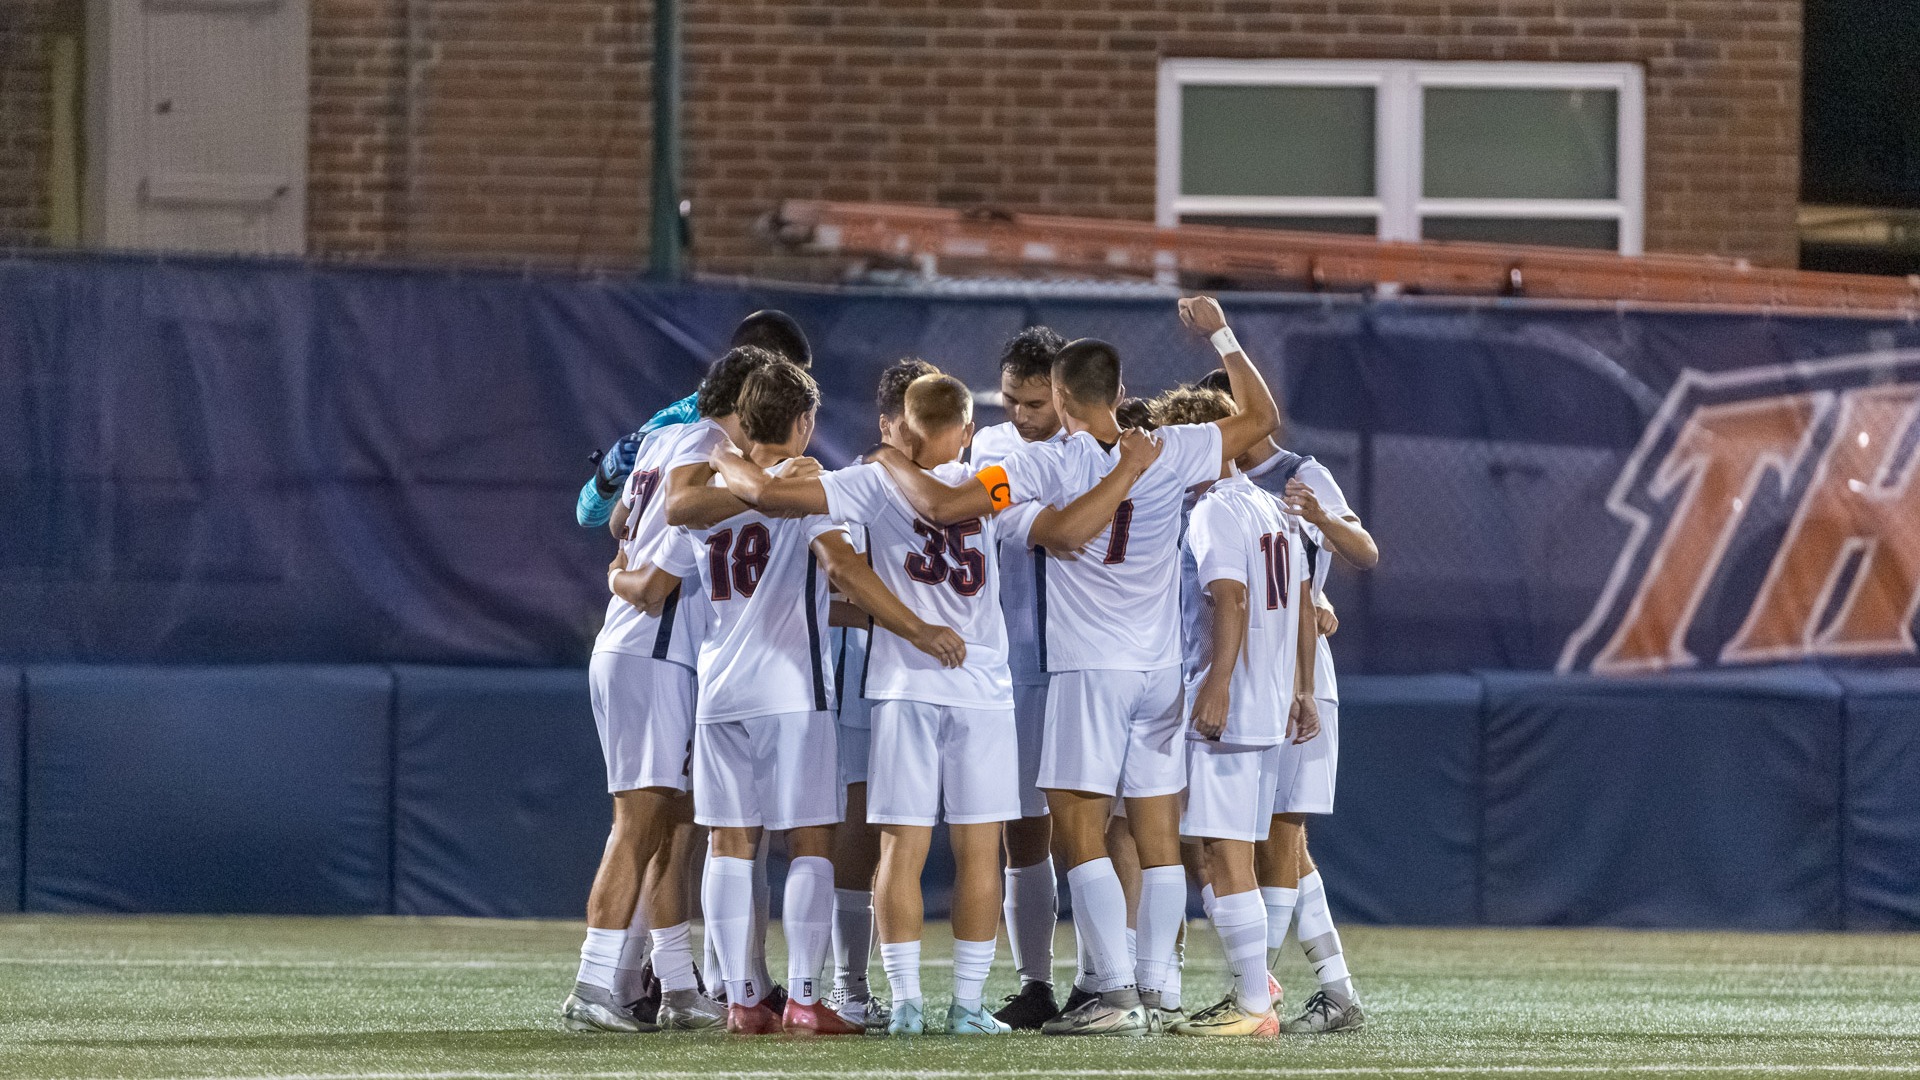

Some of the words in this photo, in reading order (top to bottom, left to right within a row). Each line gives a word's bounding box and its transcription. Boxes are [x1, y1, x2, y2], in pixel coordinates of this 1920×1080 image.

[990, 482, 1011, 502] C
[704, 521, 771, 602] 18
[903, 517, 986, 597] 35
[1259, 531, 1290, 611] 10
